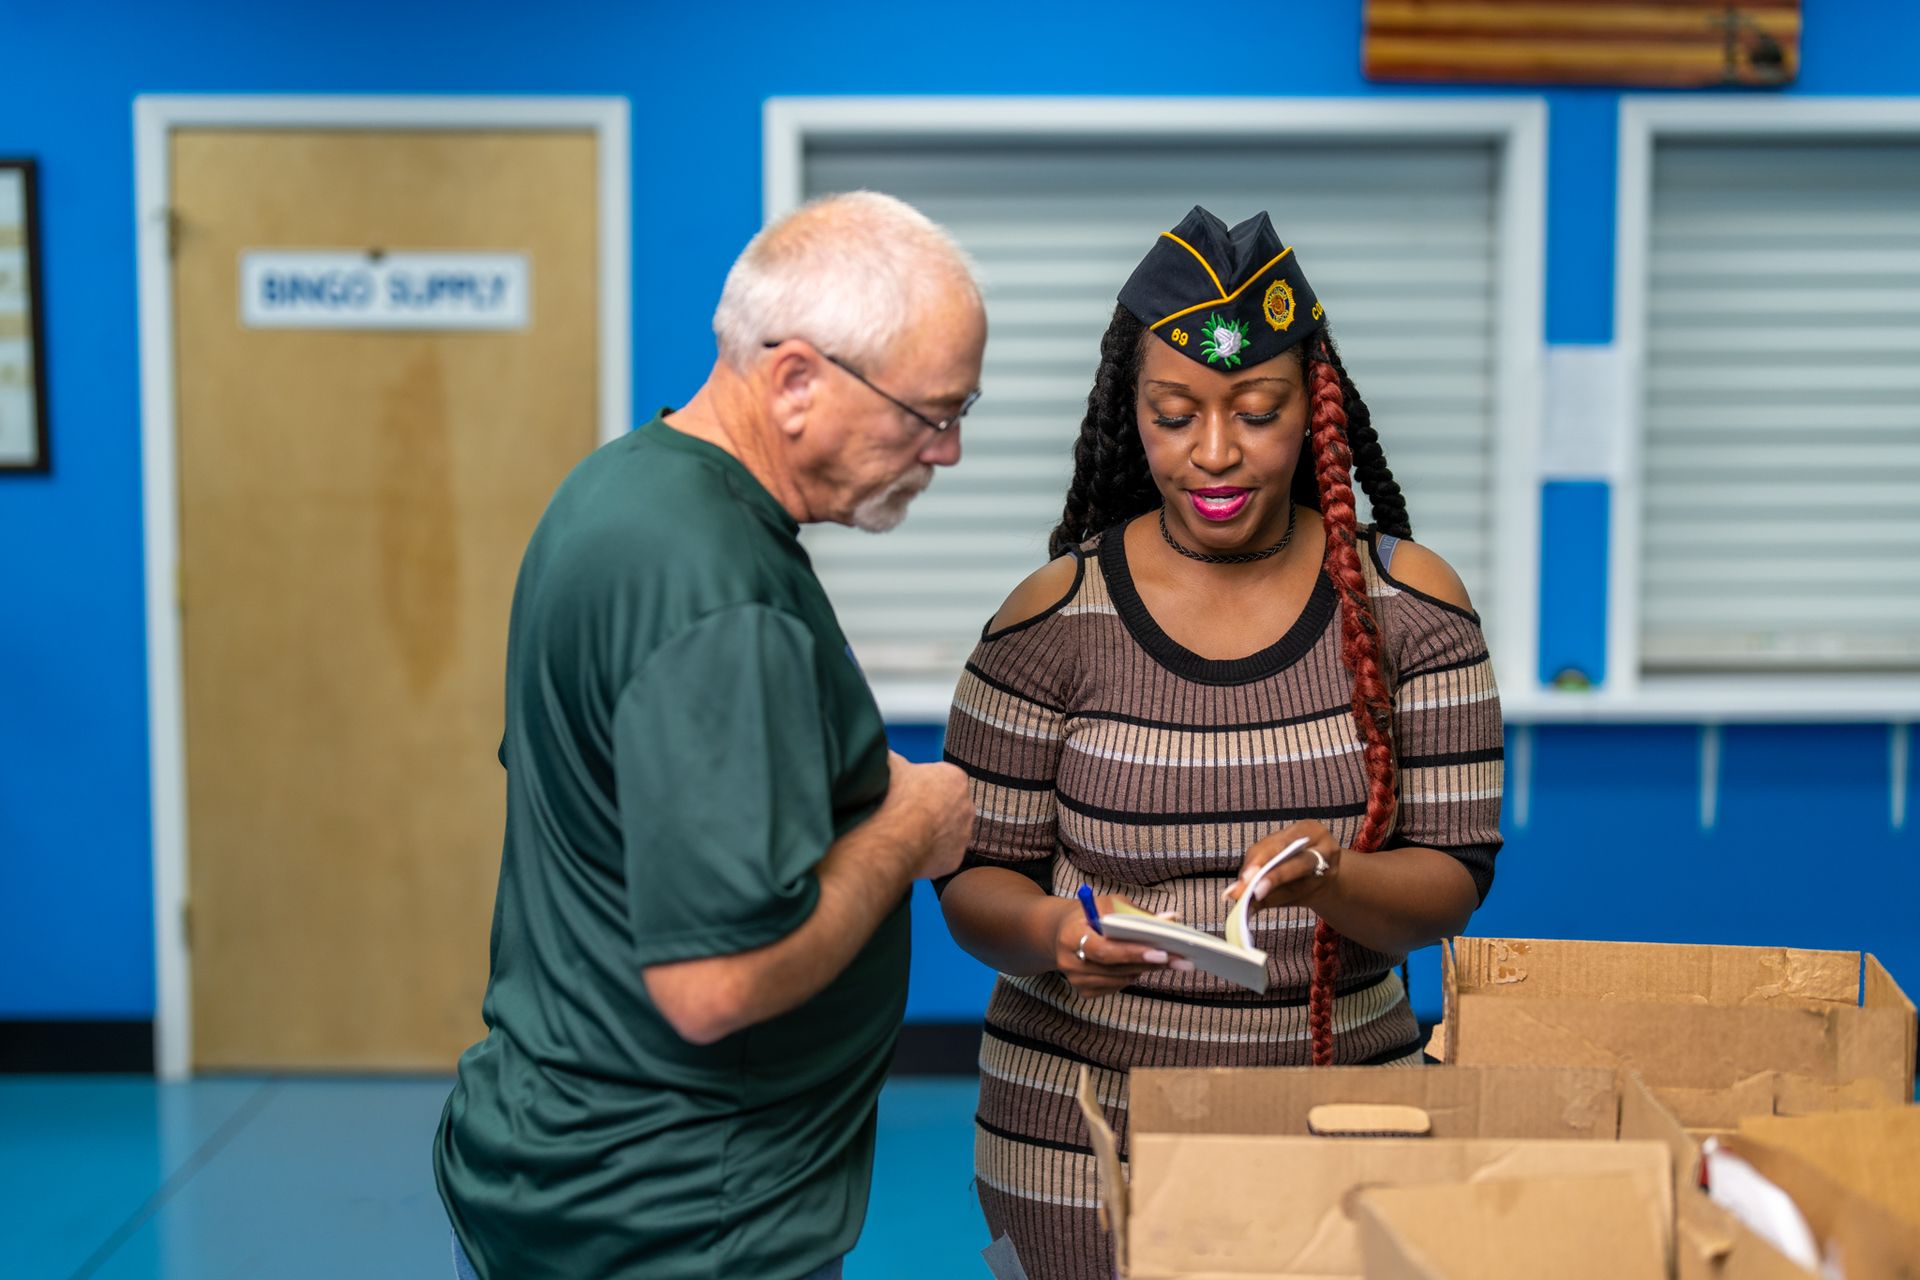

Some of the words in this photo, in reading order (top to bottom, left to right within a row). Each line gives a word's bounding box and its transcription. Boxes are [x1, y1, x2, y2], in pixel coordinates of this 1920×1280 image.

[262, 270, 373, 308] BINGO
[387, 270, 507, 309] SUPPLY
[1171, 328, 1188, 346] 69
